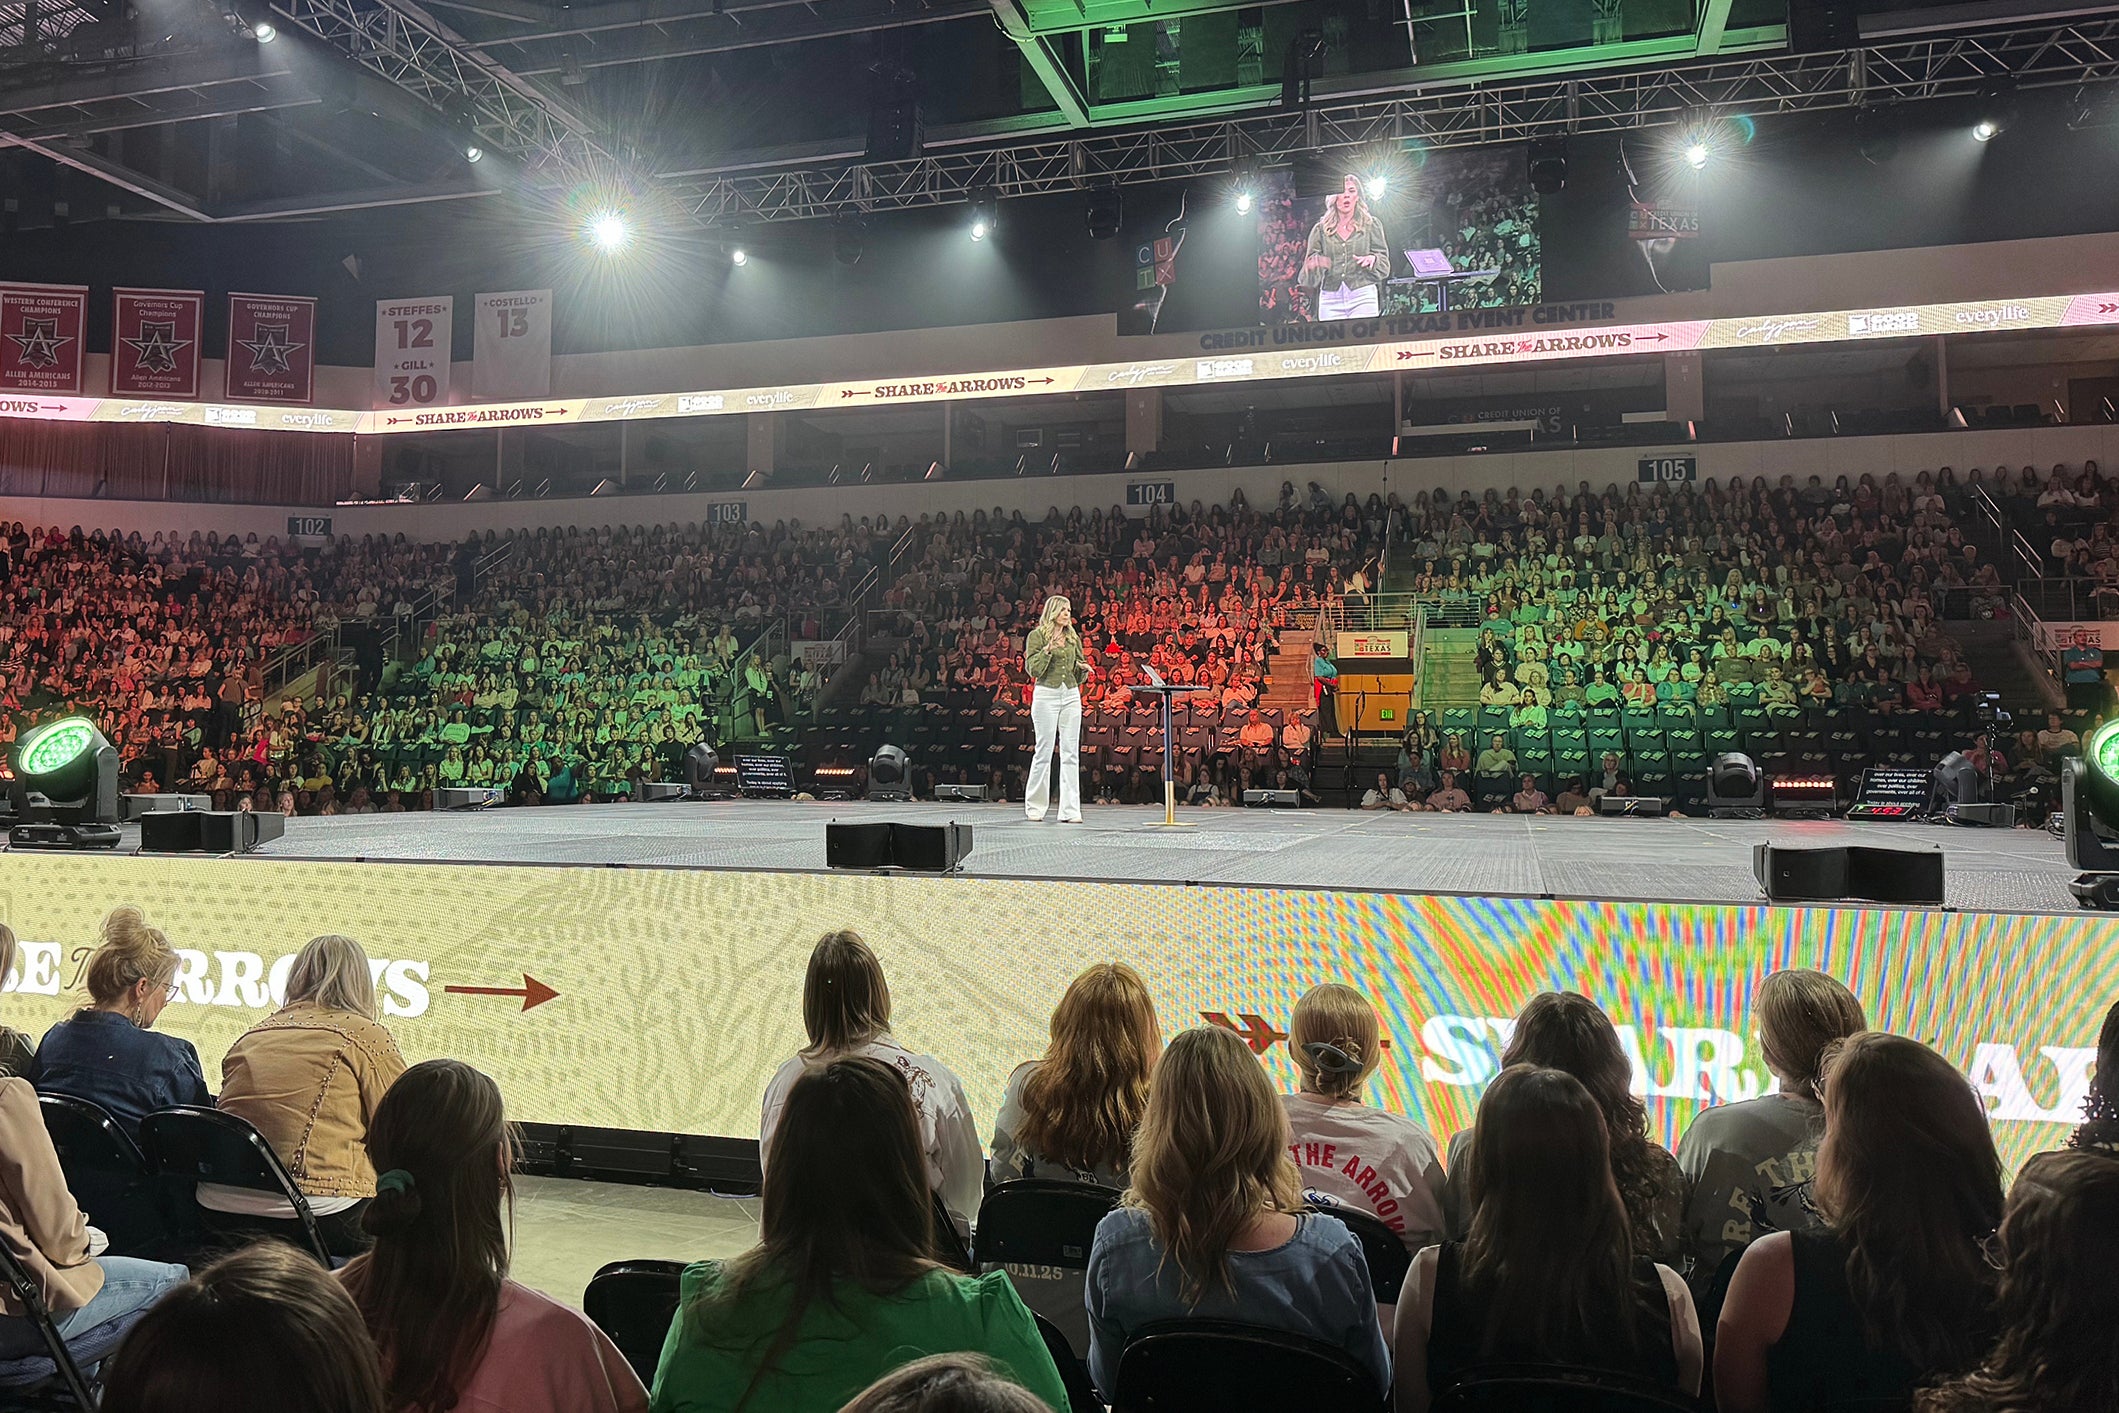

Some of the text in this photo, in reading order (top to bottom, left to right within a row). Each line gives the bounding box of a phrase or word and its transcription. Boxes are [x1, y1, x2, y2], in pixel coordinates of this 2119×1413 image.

[20, 306, 62, 314] CHAMPIONS
[36, 298, 78, 308] CONFERENCE
[170, 302, 183, 310] Cup
[388, 304, 441, 316] STEFFES
[489, 297, 536, 307] COSTELLO
[140, 310, 176, 318] Champions
[254, 312, 290, 320] CHAMPIONS
[1956, 306, 2029, 328] everylife
[497, 308, 528, 338] 13
[1200, 302, 1616, 350] CREDIT UNION OF TEXAS EVENT CENTER
[394, 318, 434, 349] 12
[1440, 333, 1632, 360] SHARE The ARROWS
[401, 361, 427, 370] GILL
[1282, 354, 1341, 370] everylife
[28, 372, 70, 380] AMERICANS
[389, 374, 437, 404] 30
[874, 382, 934, 398] SHARE
[947, 376, 1025, 393] ARROWS
[746, 392, 794, 408] everylife
[282, 413, 332, 428] everylife
[416, 412, 466, 425] SHARE
[477, 408, 543, 422] ARROWS
[1478, 410, 1508, 420] CREDIT
[1512, 408, 1546, 418] UNION
[1548, 407, 1560, 416] OF
[1648, 460, 1686, 480] 105
[1136, 484, 1166, 504] 104
[714, 504, 740, 521] 103
[296, 518, 324, 534] 102
[0, 940, 62, 996] E
[1288, 1142, 1336, 1168] THE
[1004, 1262, 1063, 1280] 0.11.25
